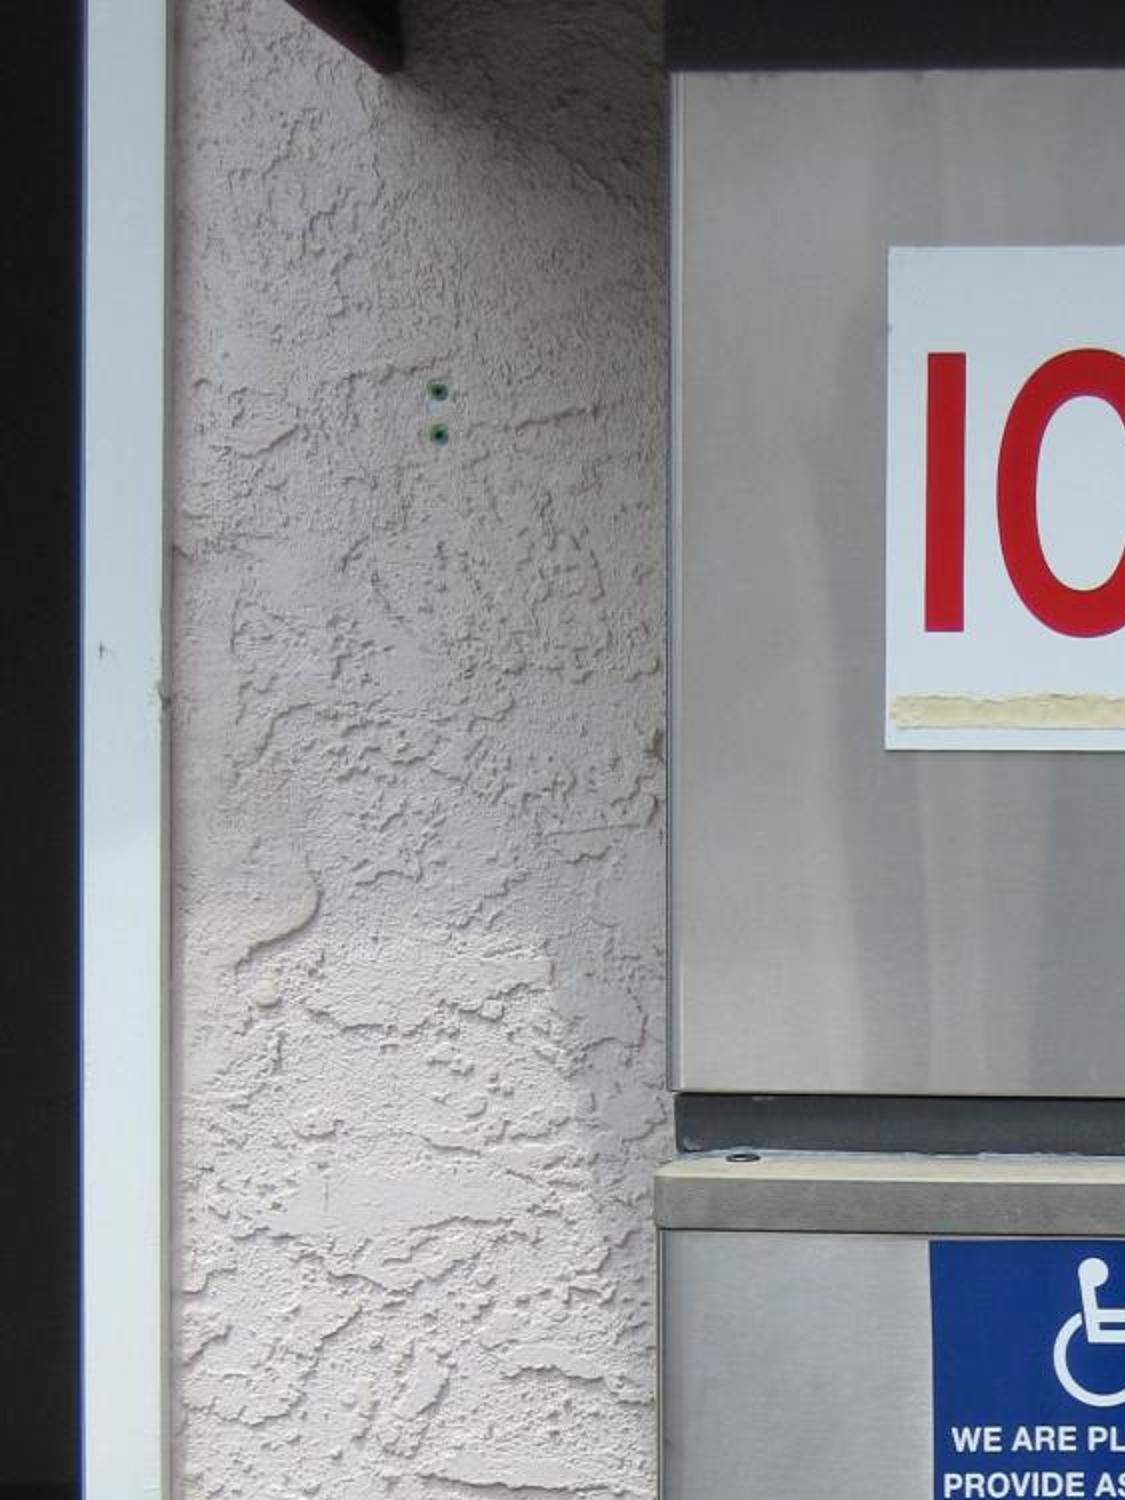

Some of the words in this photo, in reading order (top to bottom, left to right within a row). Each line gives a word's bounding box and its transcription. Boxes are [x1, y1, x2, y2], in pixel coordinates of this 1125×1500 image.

[952, 1427, 1002, 1452] WE
[1012, 1426, 1076, 1451] ARE
[944, 1472, 1084, 1499] PROVIDE
